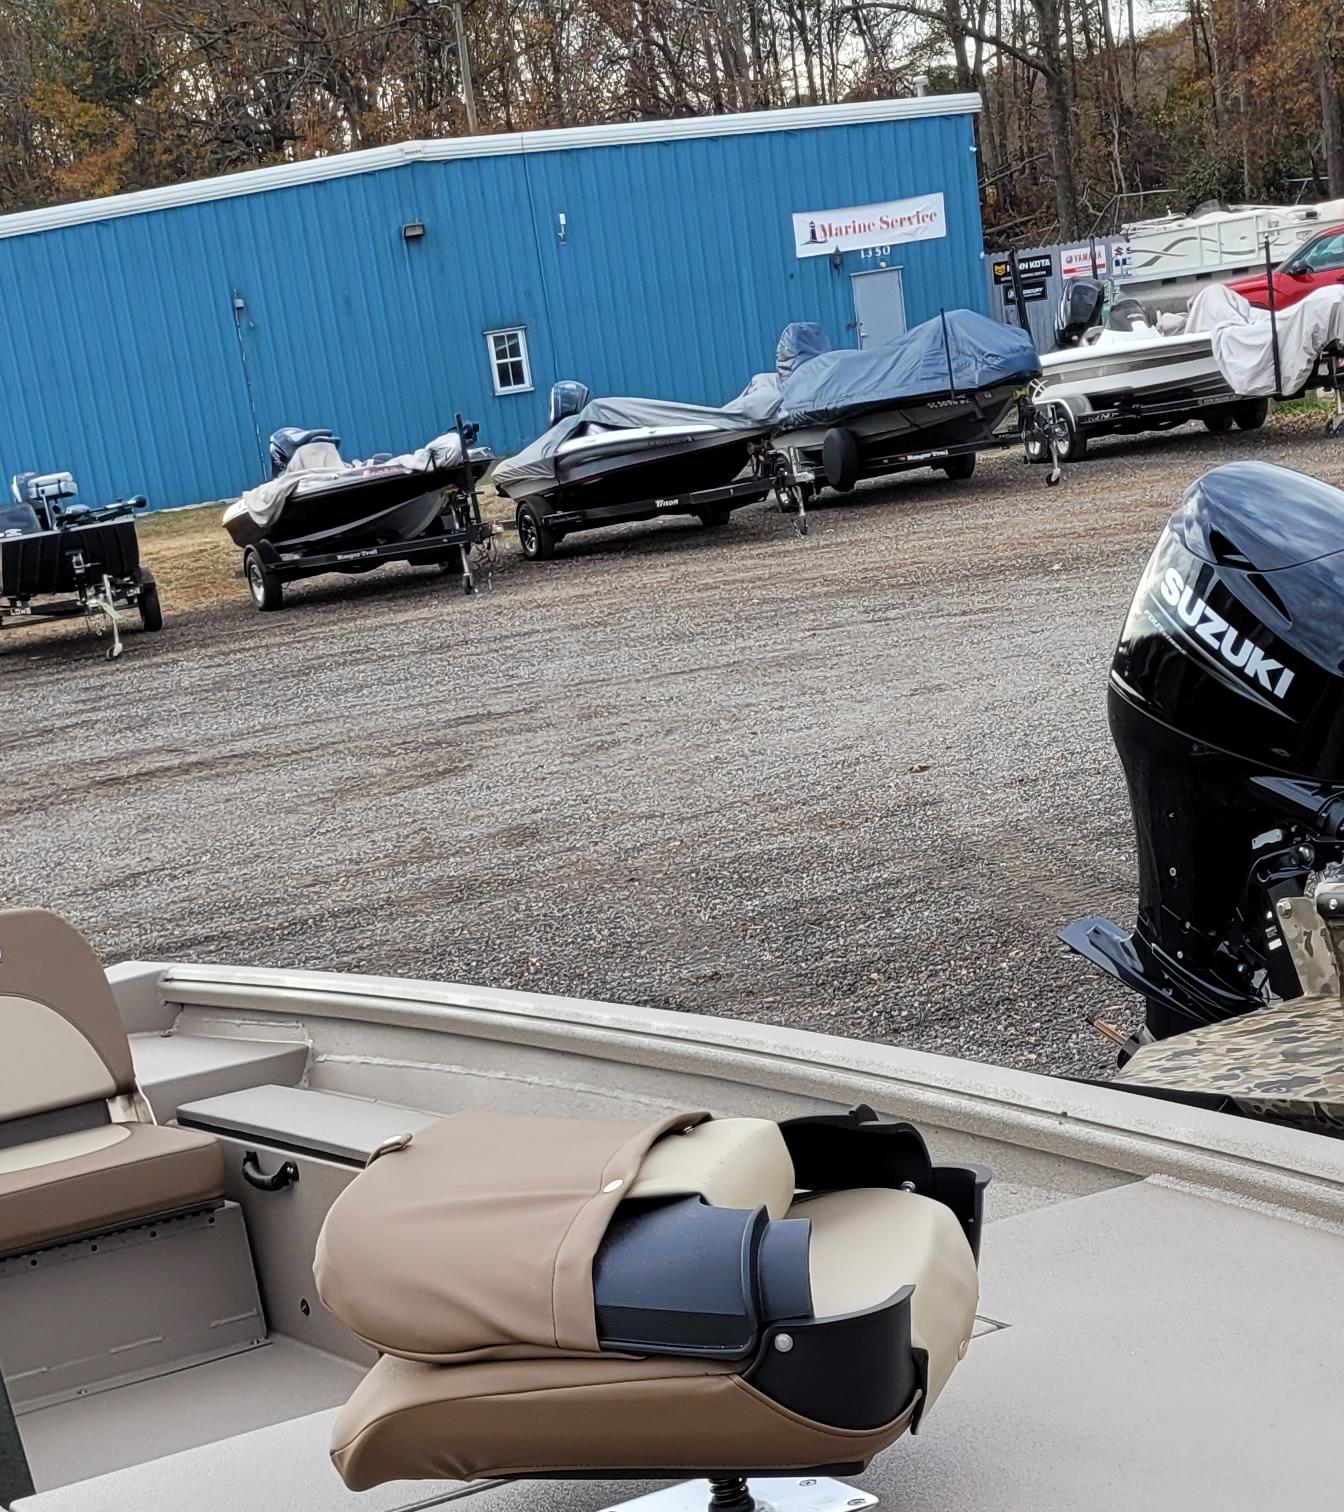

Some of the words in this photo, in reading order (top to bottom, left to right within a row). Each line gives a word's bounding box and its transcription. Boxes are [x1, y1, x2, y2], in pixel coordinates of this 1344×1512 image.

[819, 220, 875, 239] Marine
[879, 210, 938, 231] Service
[860, 245, 891, 259] 1350
[1073, 250, 1102, 263] YAMA
[1029, 259, 1051, 269] KOTA
[655, 499, 679, 508] Triton
[1160, 567, 1296, 699] SUZUKI
